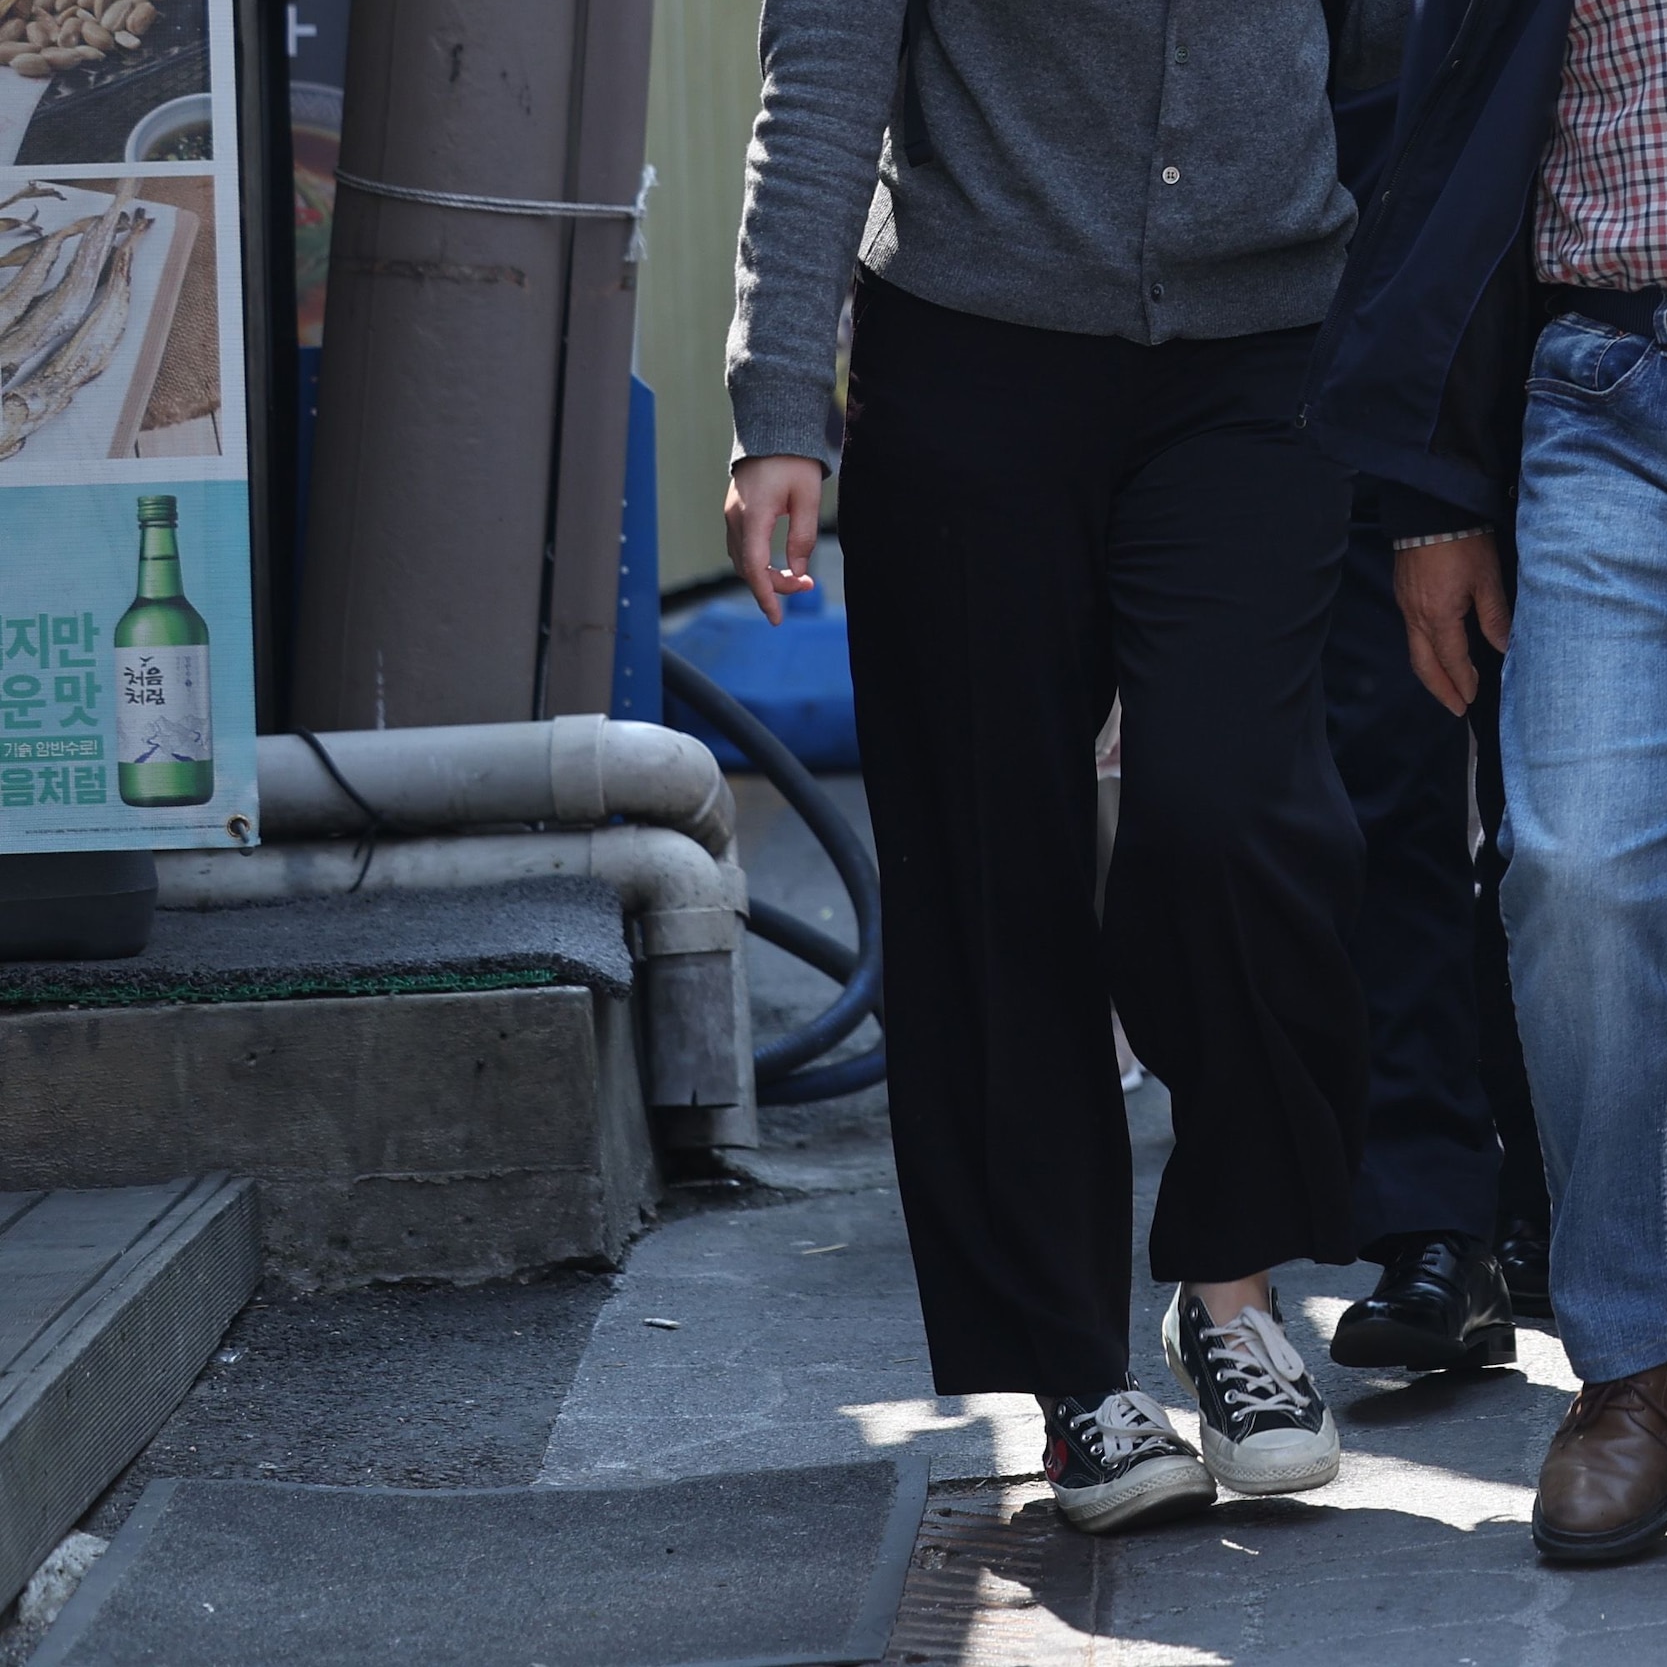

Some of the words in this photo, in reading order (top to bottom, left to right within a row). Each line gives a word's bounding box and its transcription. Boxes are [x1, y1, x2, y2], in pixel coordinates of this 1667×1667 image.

[0, 612, 99, 670] 지만
[124, 667, 165, 688] 처음
[124, 688, 166, 706] 처럼
[54, 671, 102, 729] 맛
